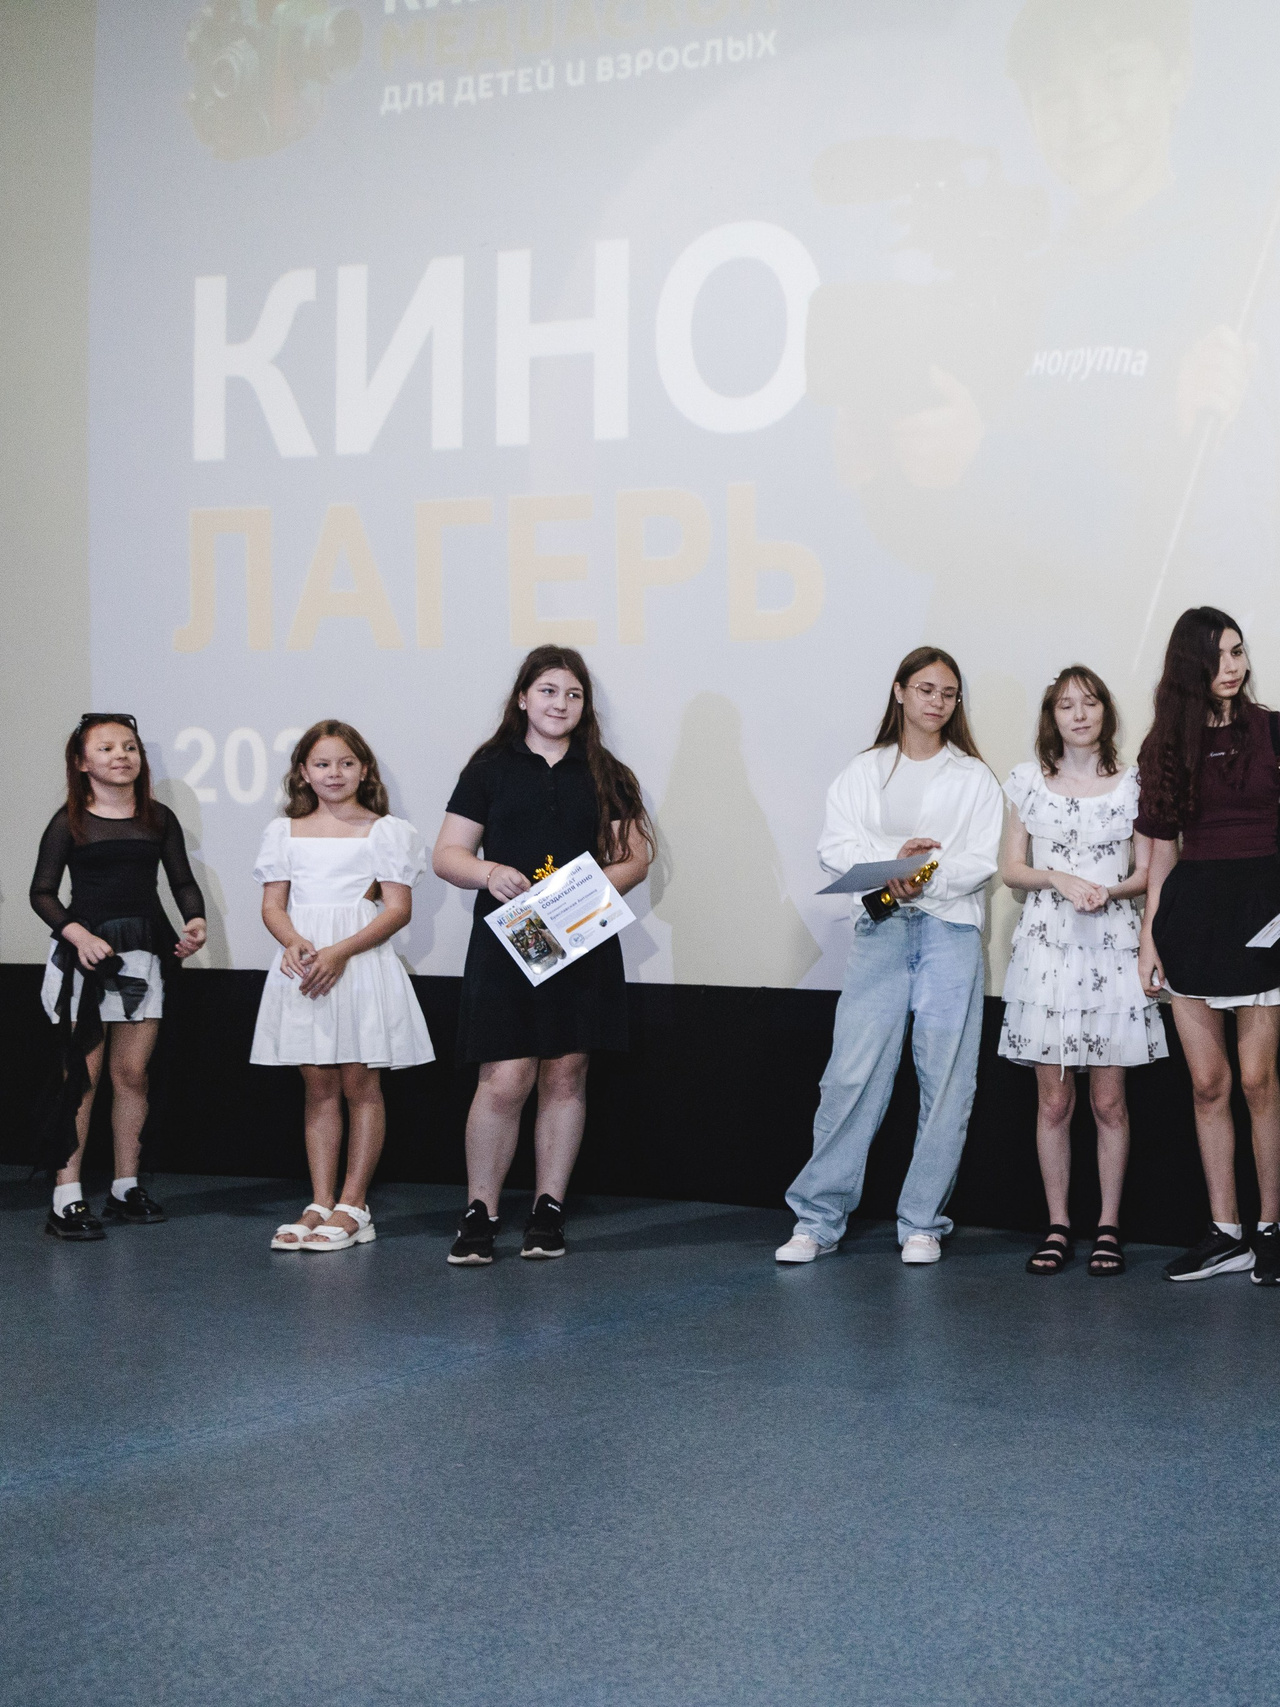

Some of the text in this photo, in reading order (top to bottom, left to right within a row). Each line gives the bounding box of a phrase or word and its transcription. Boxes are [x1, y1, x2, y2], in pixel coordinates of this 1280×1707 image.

[379, 80, 446, 116] ДЛЯ
[453, 60, 556, 108] ДЕТЕЙ
[595, 28, 779, 83] ВЗРОСЛЫХ
[191, 219, 821, 464] КИНО
[173, 481, 828, 654] ЛАГЕРЬ
